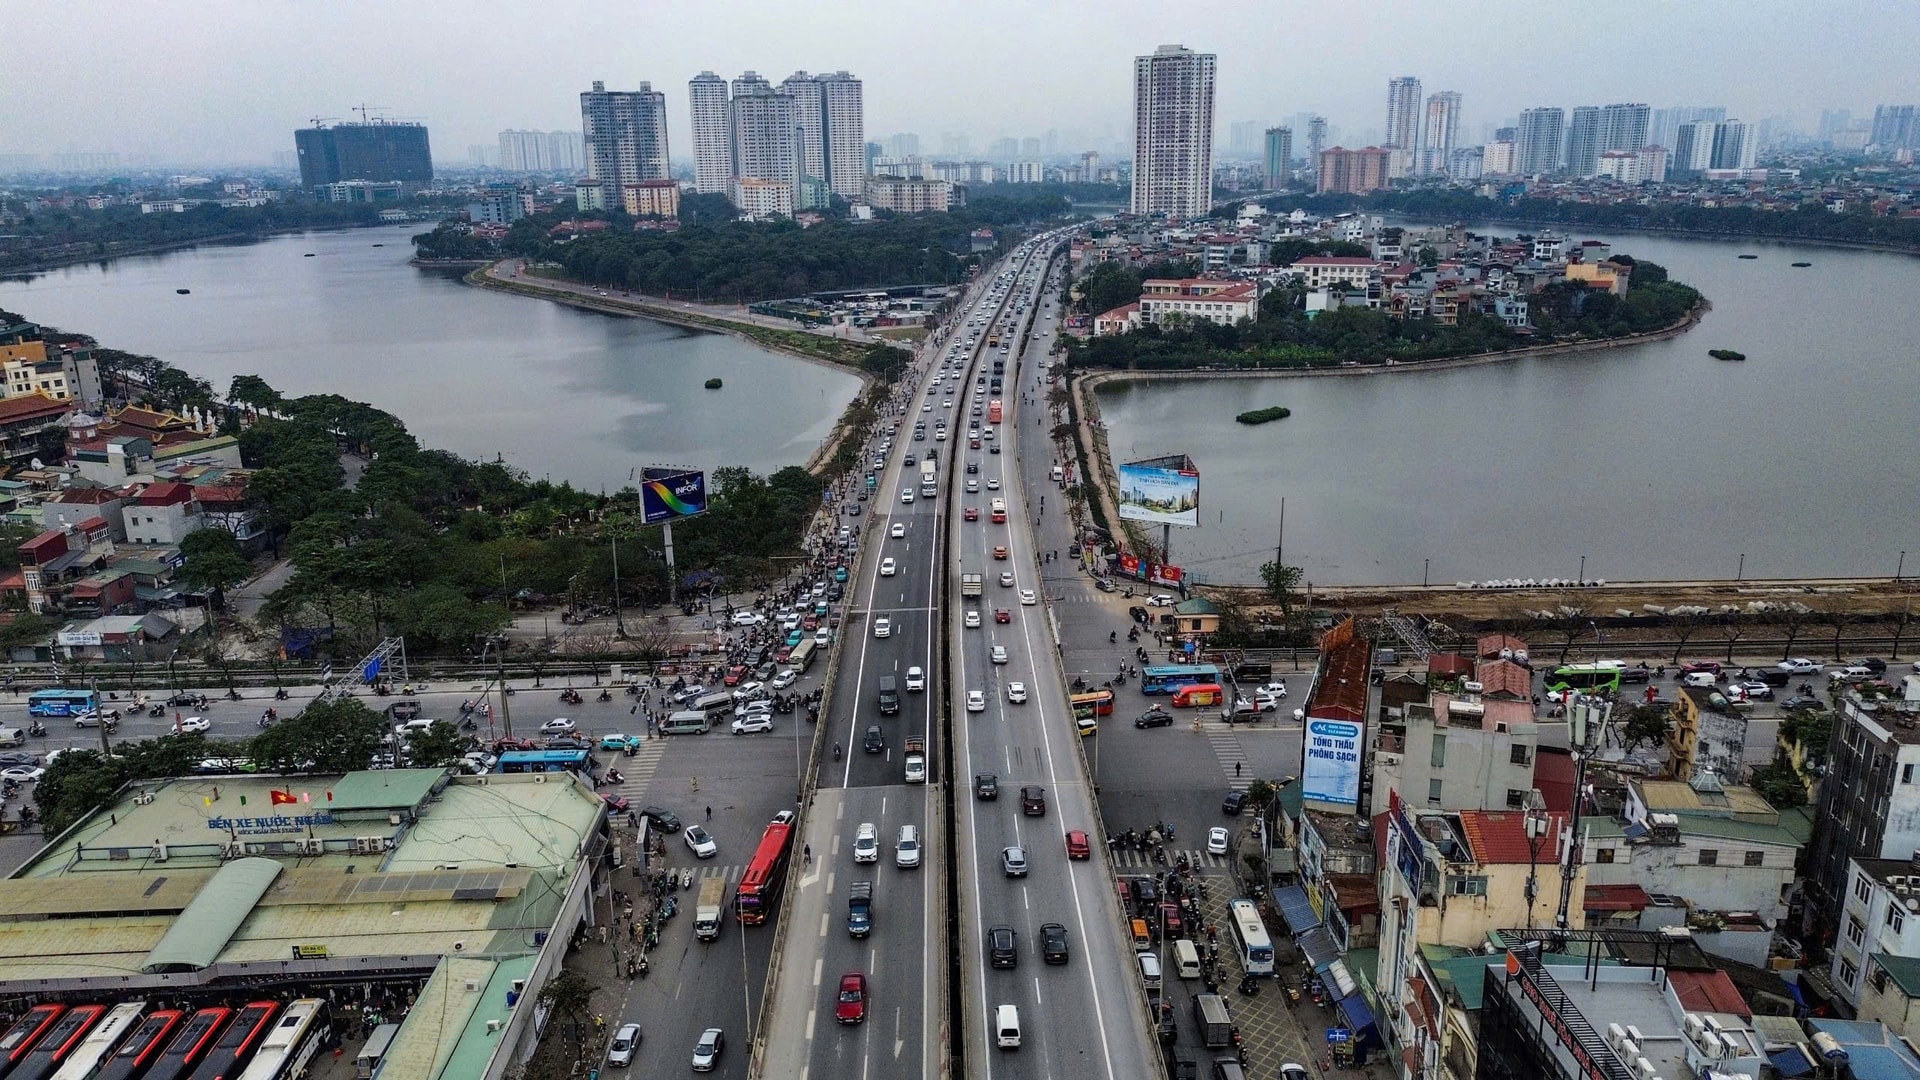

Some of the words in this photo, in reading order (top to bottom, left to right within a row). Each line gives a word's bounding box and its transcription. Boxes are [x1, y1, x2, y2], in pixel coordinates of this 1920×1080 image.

[675, 484, 698, 494] INFOR
[1308, 747, 1334, 760] PHÒNG
[1336, 752, 1357, 763] SẠCH
[208, 815, 232, 829] BẾN
[236, 818, 252, 828] XE
[256, 814, 291, 827] NƯỚC
